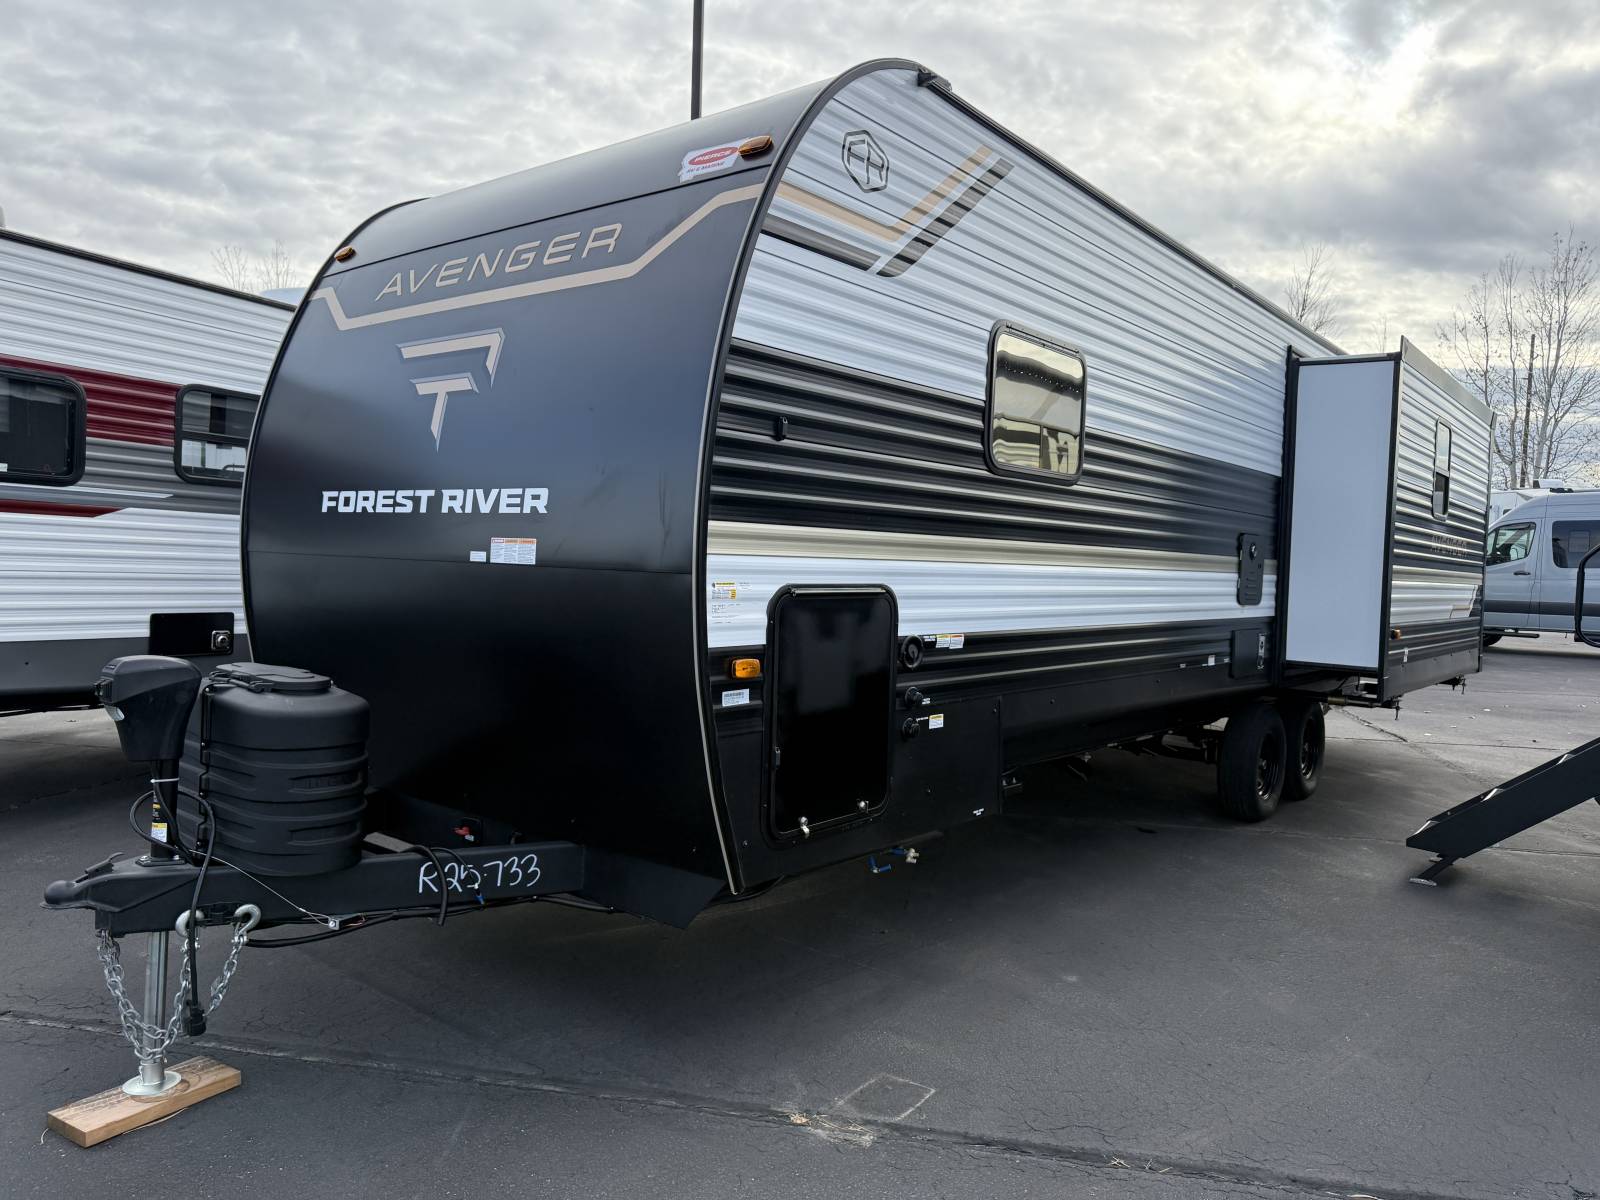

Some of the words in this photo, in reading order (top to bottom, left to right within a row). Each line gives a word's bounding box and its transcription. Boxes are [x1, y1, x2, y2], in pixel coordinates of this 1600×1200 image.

[375, 223, 622, 301] AVENGER
[321, 490, 436, 514] FOREST
[441, 487, 549, 514] RIVER
